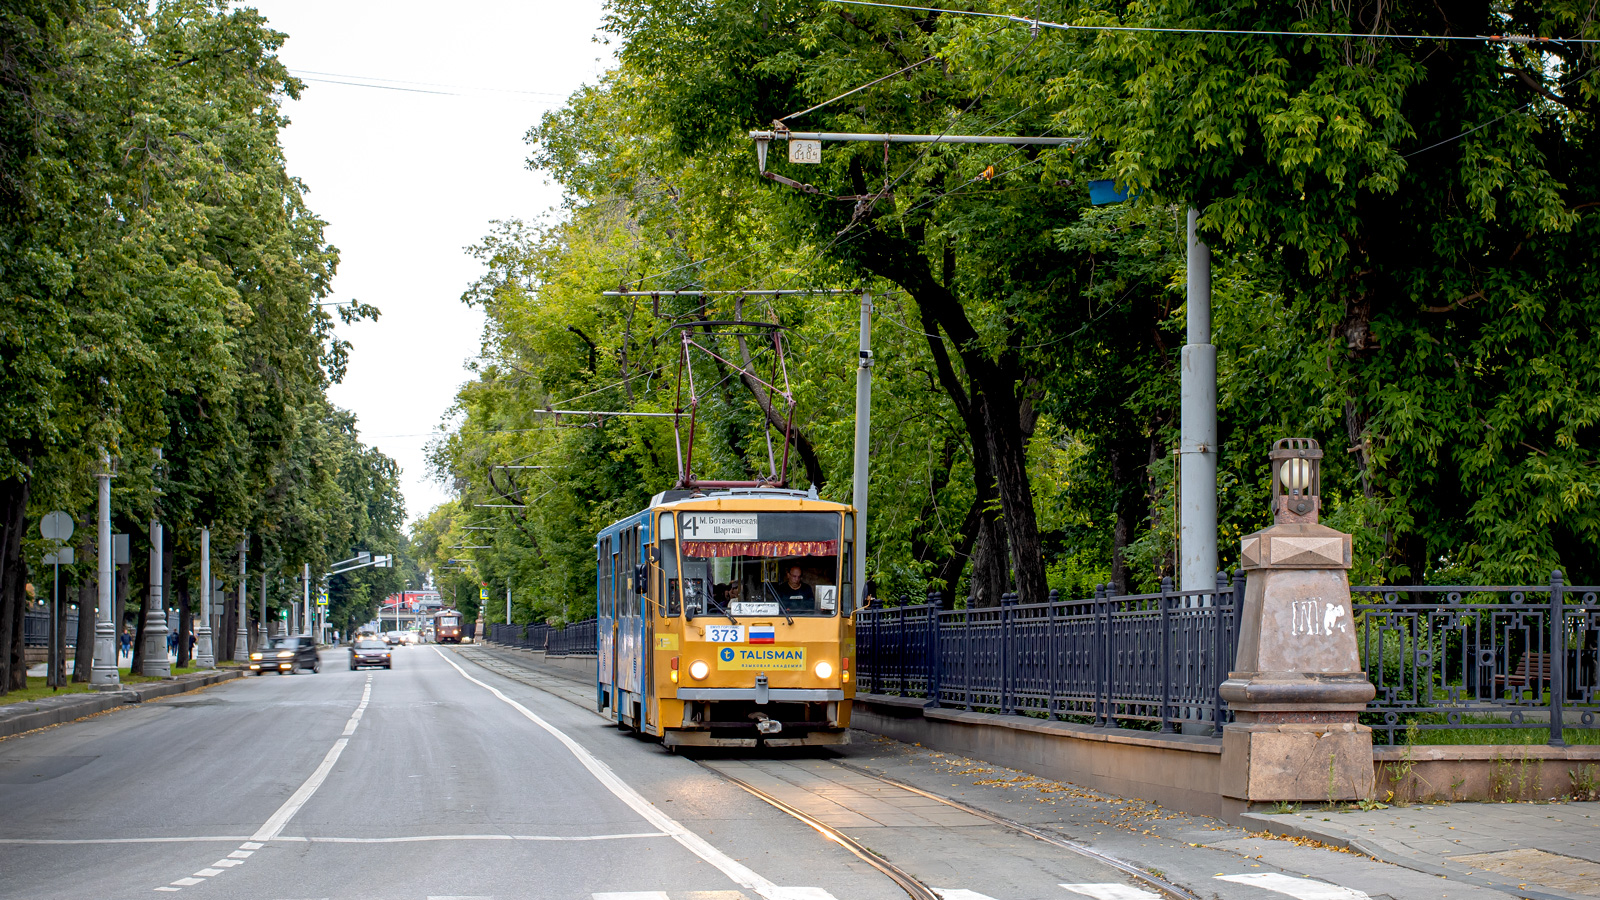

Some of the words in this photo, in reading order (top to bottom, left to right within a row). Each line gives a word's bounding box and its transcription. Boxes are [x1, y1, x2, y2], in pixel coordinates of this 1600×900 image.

[683, 516, 699, 536] 4
[708, 516, 758, 525] Ботаническая
[713, 526, 742, 535] Шарташ
[823, 589, 835, 604] 4
[734, 603, 743, 614] 4
[712, 630, 738, 642] 373
[739, 650, 803, 660] TALISMAN
